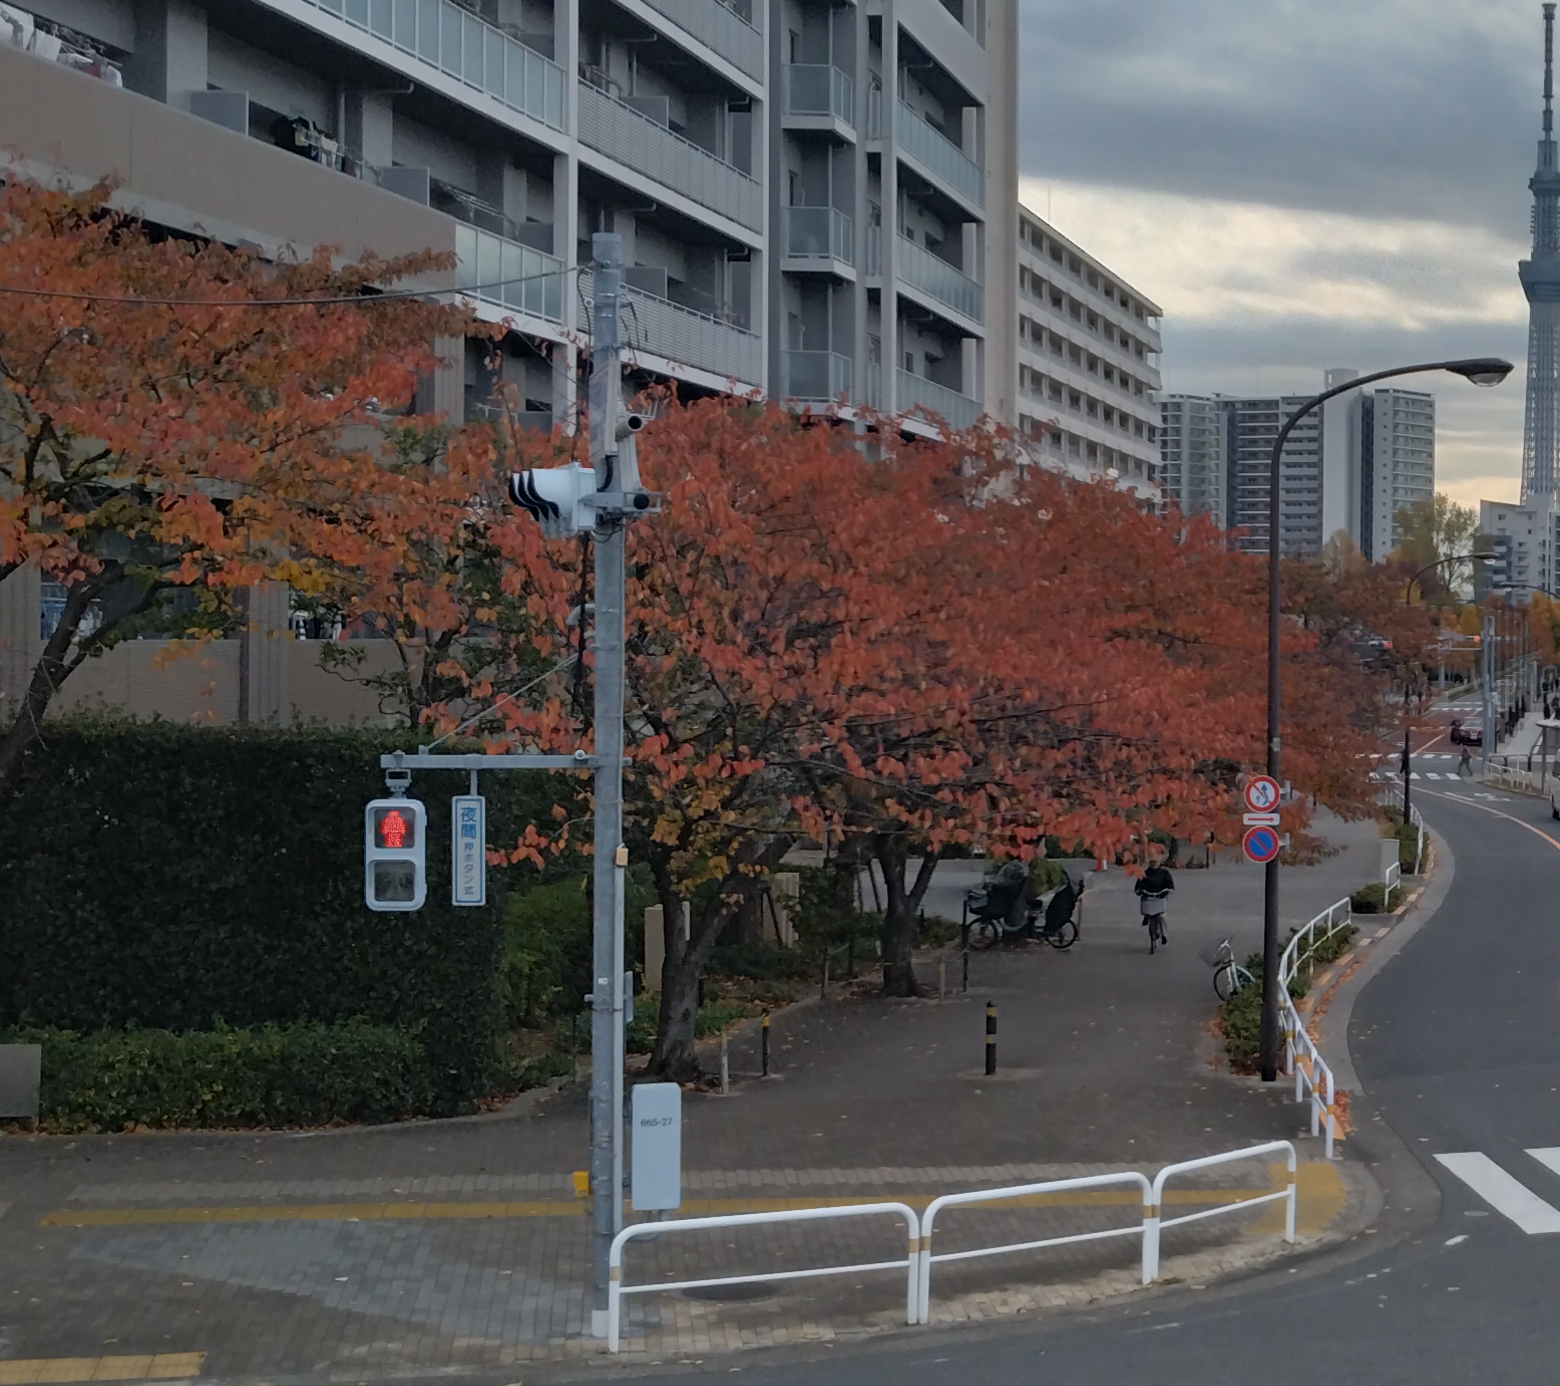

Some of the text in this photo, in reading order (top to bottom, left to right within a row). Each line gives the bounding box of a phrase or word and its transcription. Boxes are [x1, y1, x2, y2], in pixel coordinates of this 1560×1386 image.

[461, 807, 477, 895] 夜間押ボタン式
